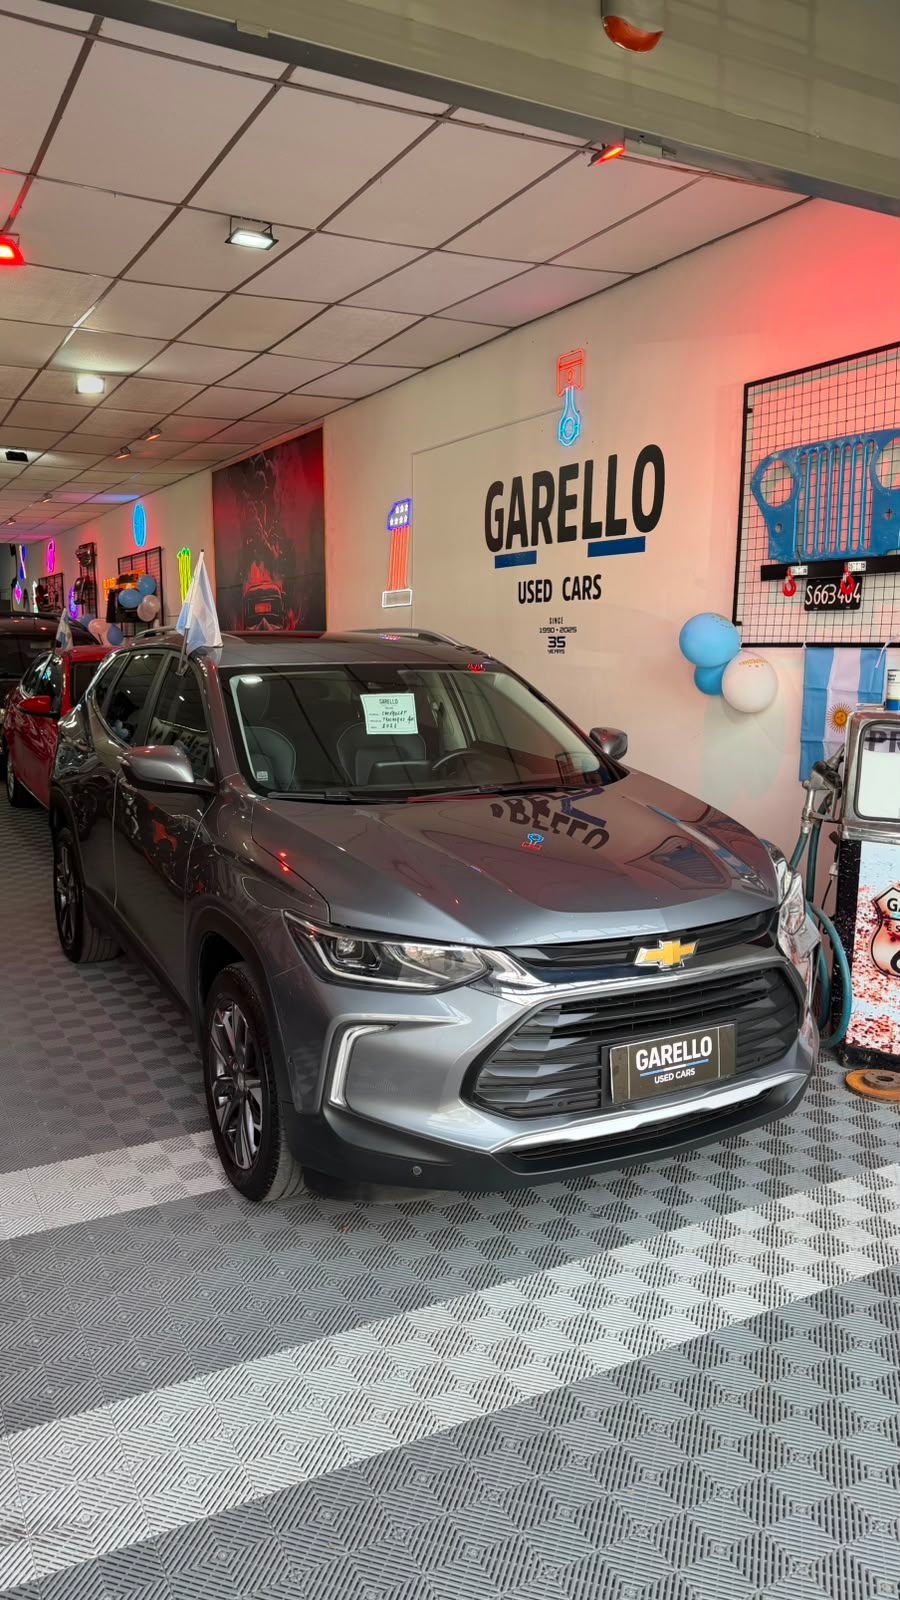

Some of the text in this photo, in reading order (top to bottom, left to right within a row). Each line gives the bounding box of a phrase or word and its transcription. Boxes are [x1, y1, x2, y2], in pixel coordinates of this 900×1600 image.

[484, 444, 665, 553] GARELLO
[518, 574, 602, 604] USED CARS
[548, 636, 566, 648] 35
[887, 898, 900, 912] G
[635, 1036, 713, 1071] GARELLO
[654, 1067, 696, 1084] USED CARS
